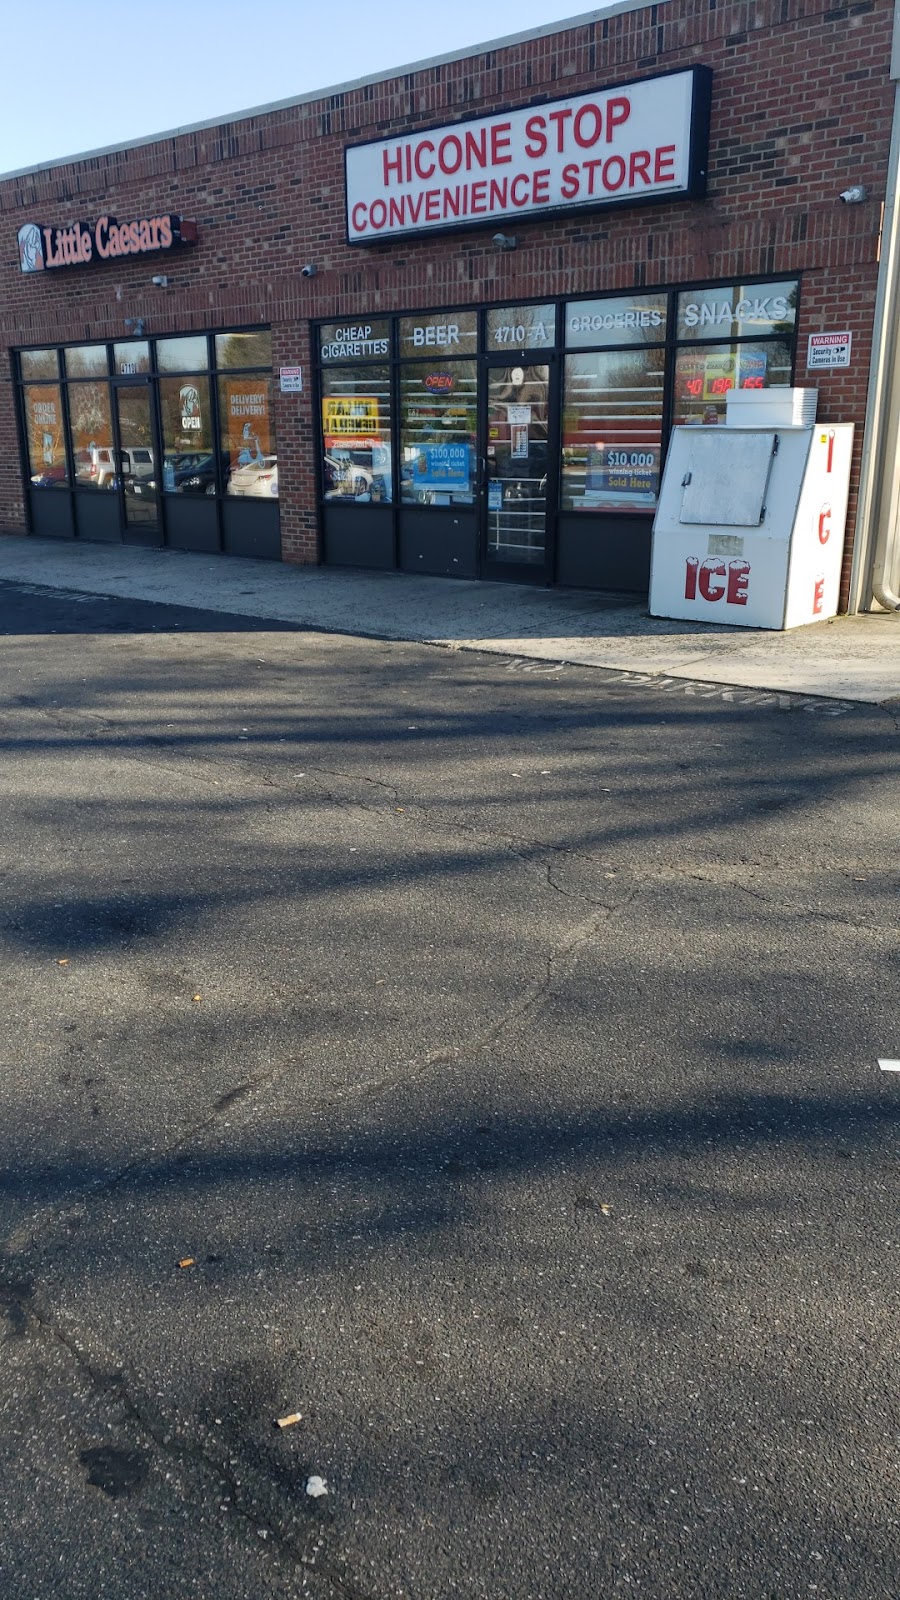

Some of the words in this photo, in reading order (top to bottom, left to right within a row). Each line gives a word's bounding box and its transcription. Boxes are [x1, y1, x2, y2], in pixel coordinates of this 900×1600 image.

[383, 122, 512, 187] HICONE
[524, 96, 631, 158] STOP
[352, 169, 551, 232] CONVENIENCE
[560, 144, 677, 199] STORE
[44, 222, 92, 267] Little
[96, 215, 173, 259] Caesars
[684, 296, 789, 327] SNACKS
[569, 310, 662, 332] GROCERIES
[335, 326, 372, 342] CHEAP
[413, 324, 460, 346] BEER
[812, 335, 848, 345] WARNING
[321, 340, 388, 358] CIGARETTES
[813, 347, 832, 356] Security
[812, 356, 831, 364] Cameras
[425, 376, 453, 387] OPEN
[230, 394, 265, 405] DELIVERY!
[33, 402, 56, 413] ORDER
[231, 405, 266, 416] DELIVERY!
[182, 416, 201, 429] OPEN
[430, 448, 465, 459] $100,000
[608, 451, 654, 467] $10,000
[609, 467, 633, 476] winning
[609, 476, 627, 487] Sold
[630, 477, 652, 488] Here
[685, 556, 751, 606] ICE
